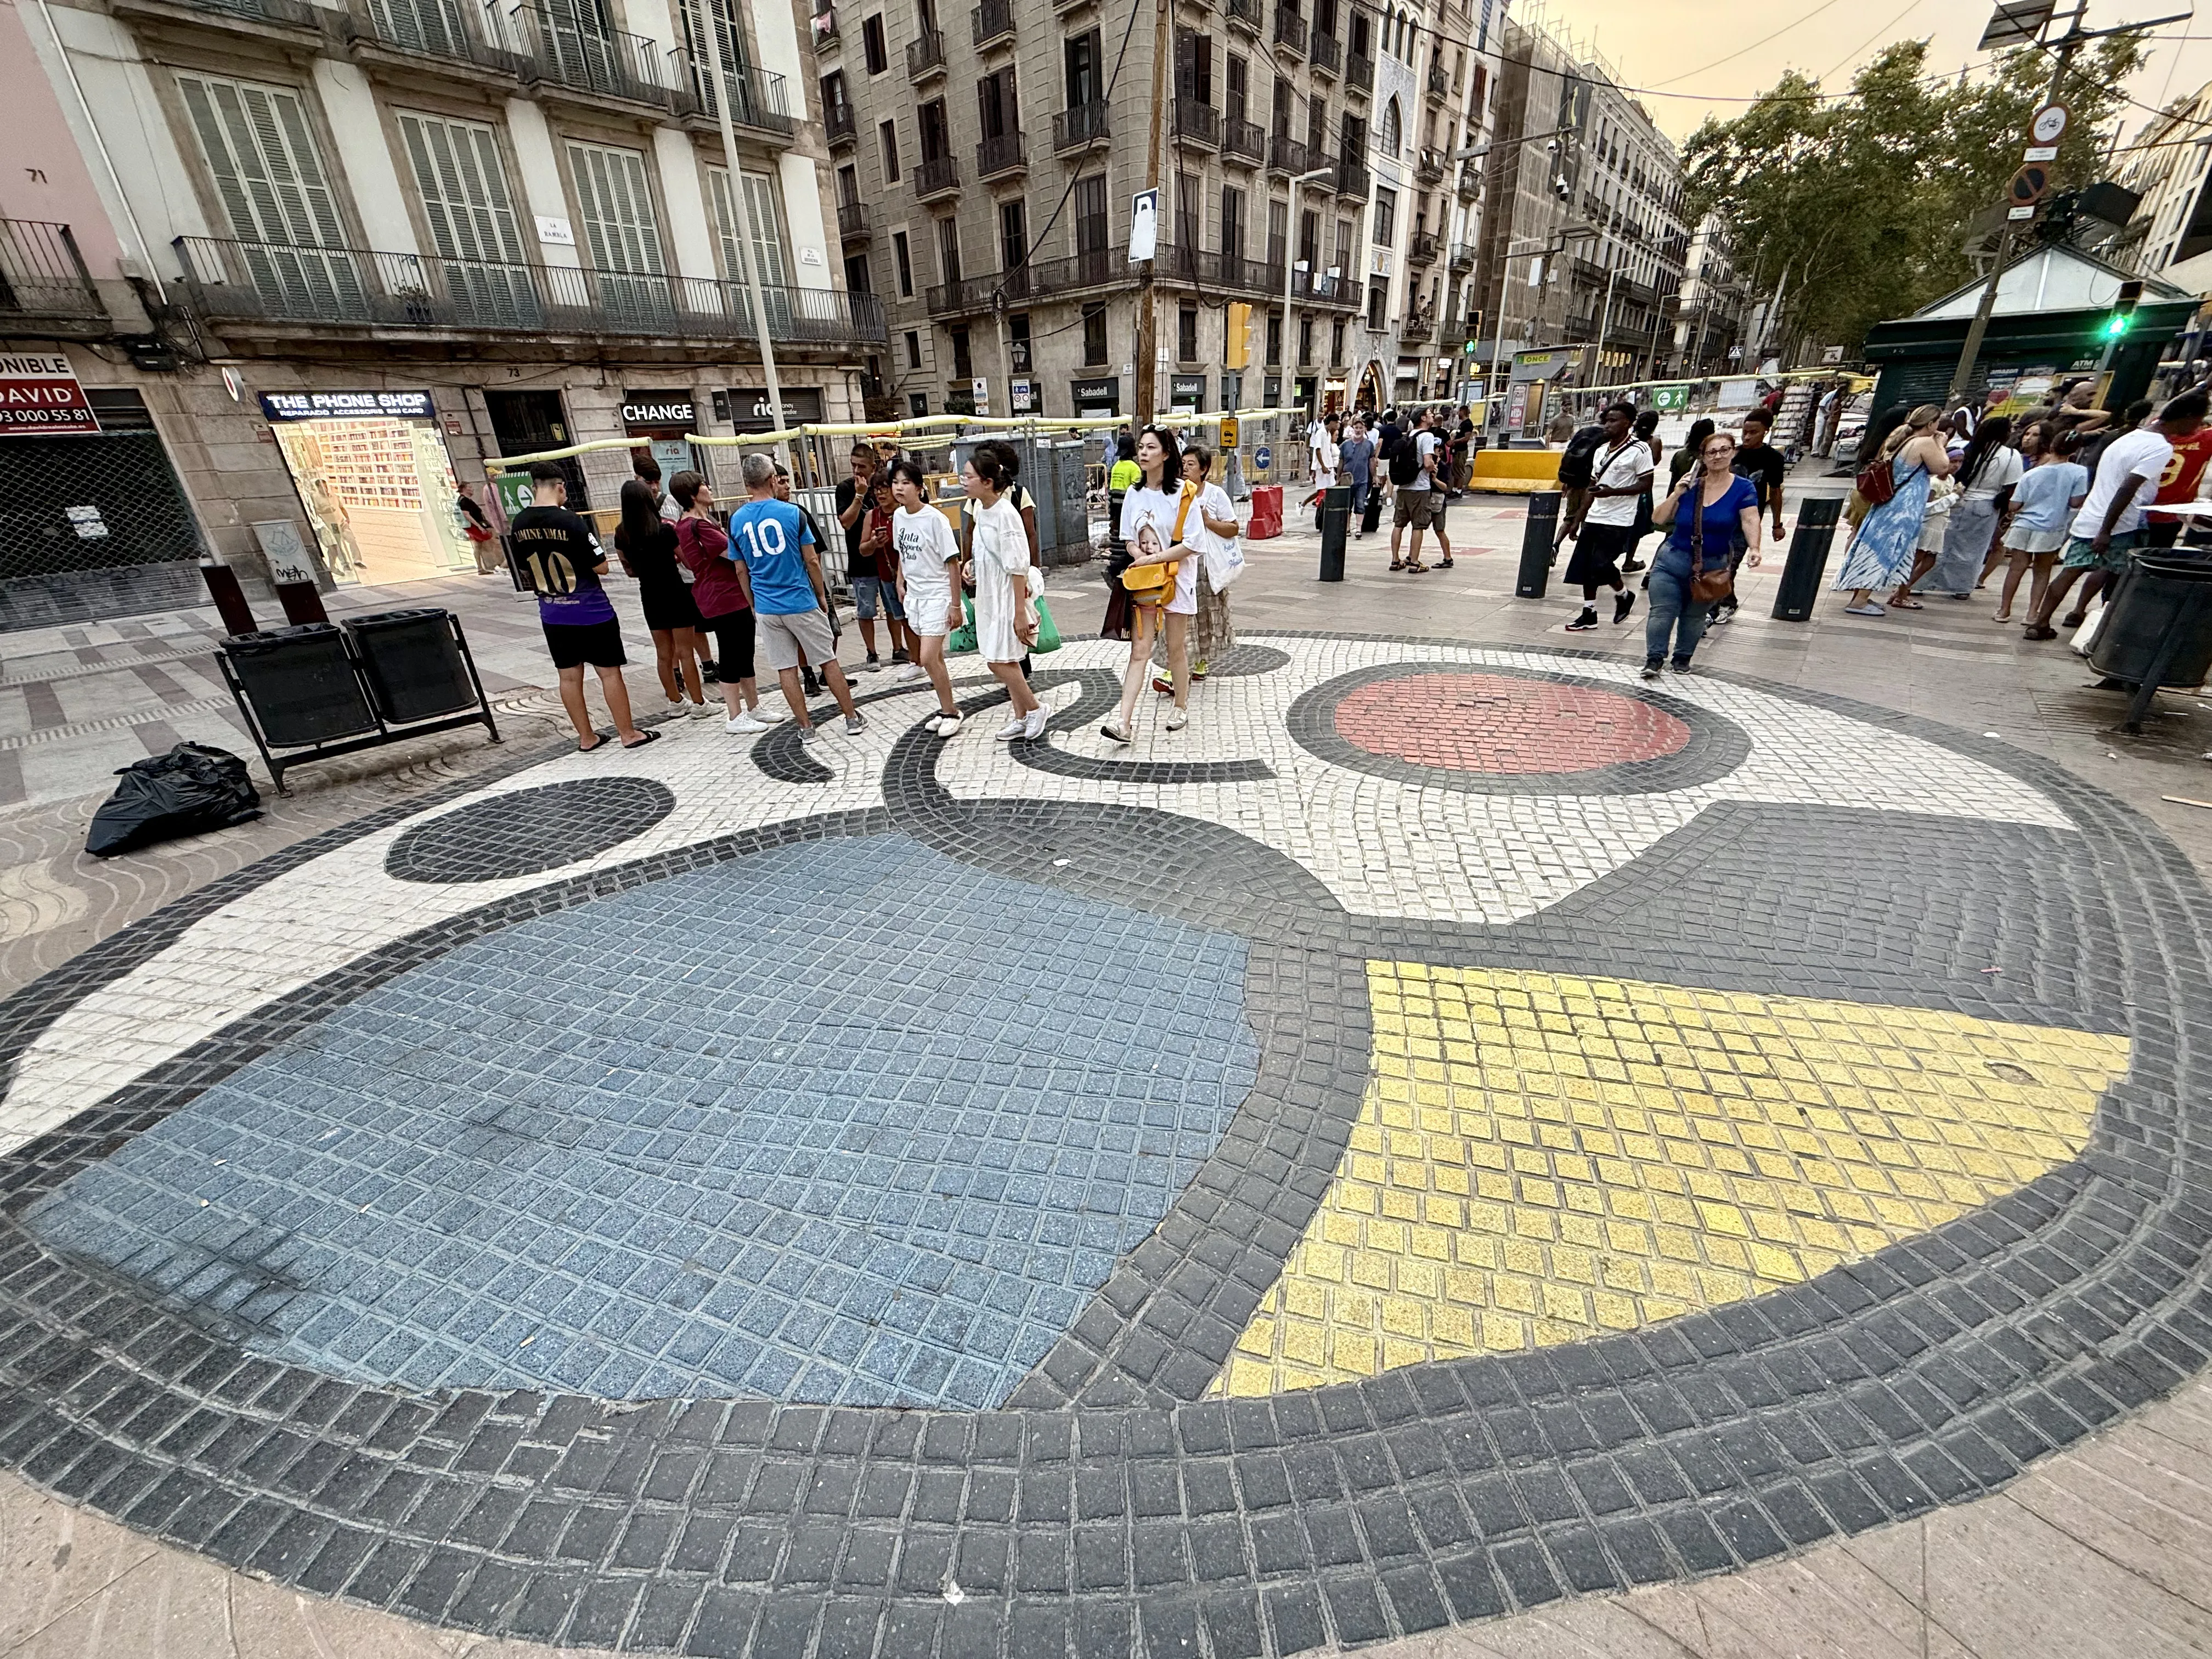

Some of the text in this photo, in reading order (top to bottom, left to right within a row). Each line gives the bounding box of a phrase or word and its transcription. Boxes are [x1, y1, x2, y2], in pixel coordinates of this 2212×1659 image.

[24, 168, 47, 184] 71
[506, 368, 520, 377] 73
[1081, 386, 1108, 397] Sabadell
[1176, 383, 1197, 392] Sabadell
[266, 393, 426, 409] THE PHONE SHOP
[15, 410, 49, 422] 000
[50, 410, 71, 421] 55
[72, 409, 90, 420] 81
[623, 404, 693, 421] CHANGE
[666, 445, 680, 455] ria
[743, 518, 786, 557] 10
[527, 551, 577, 596] 10
